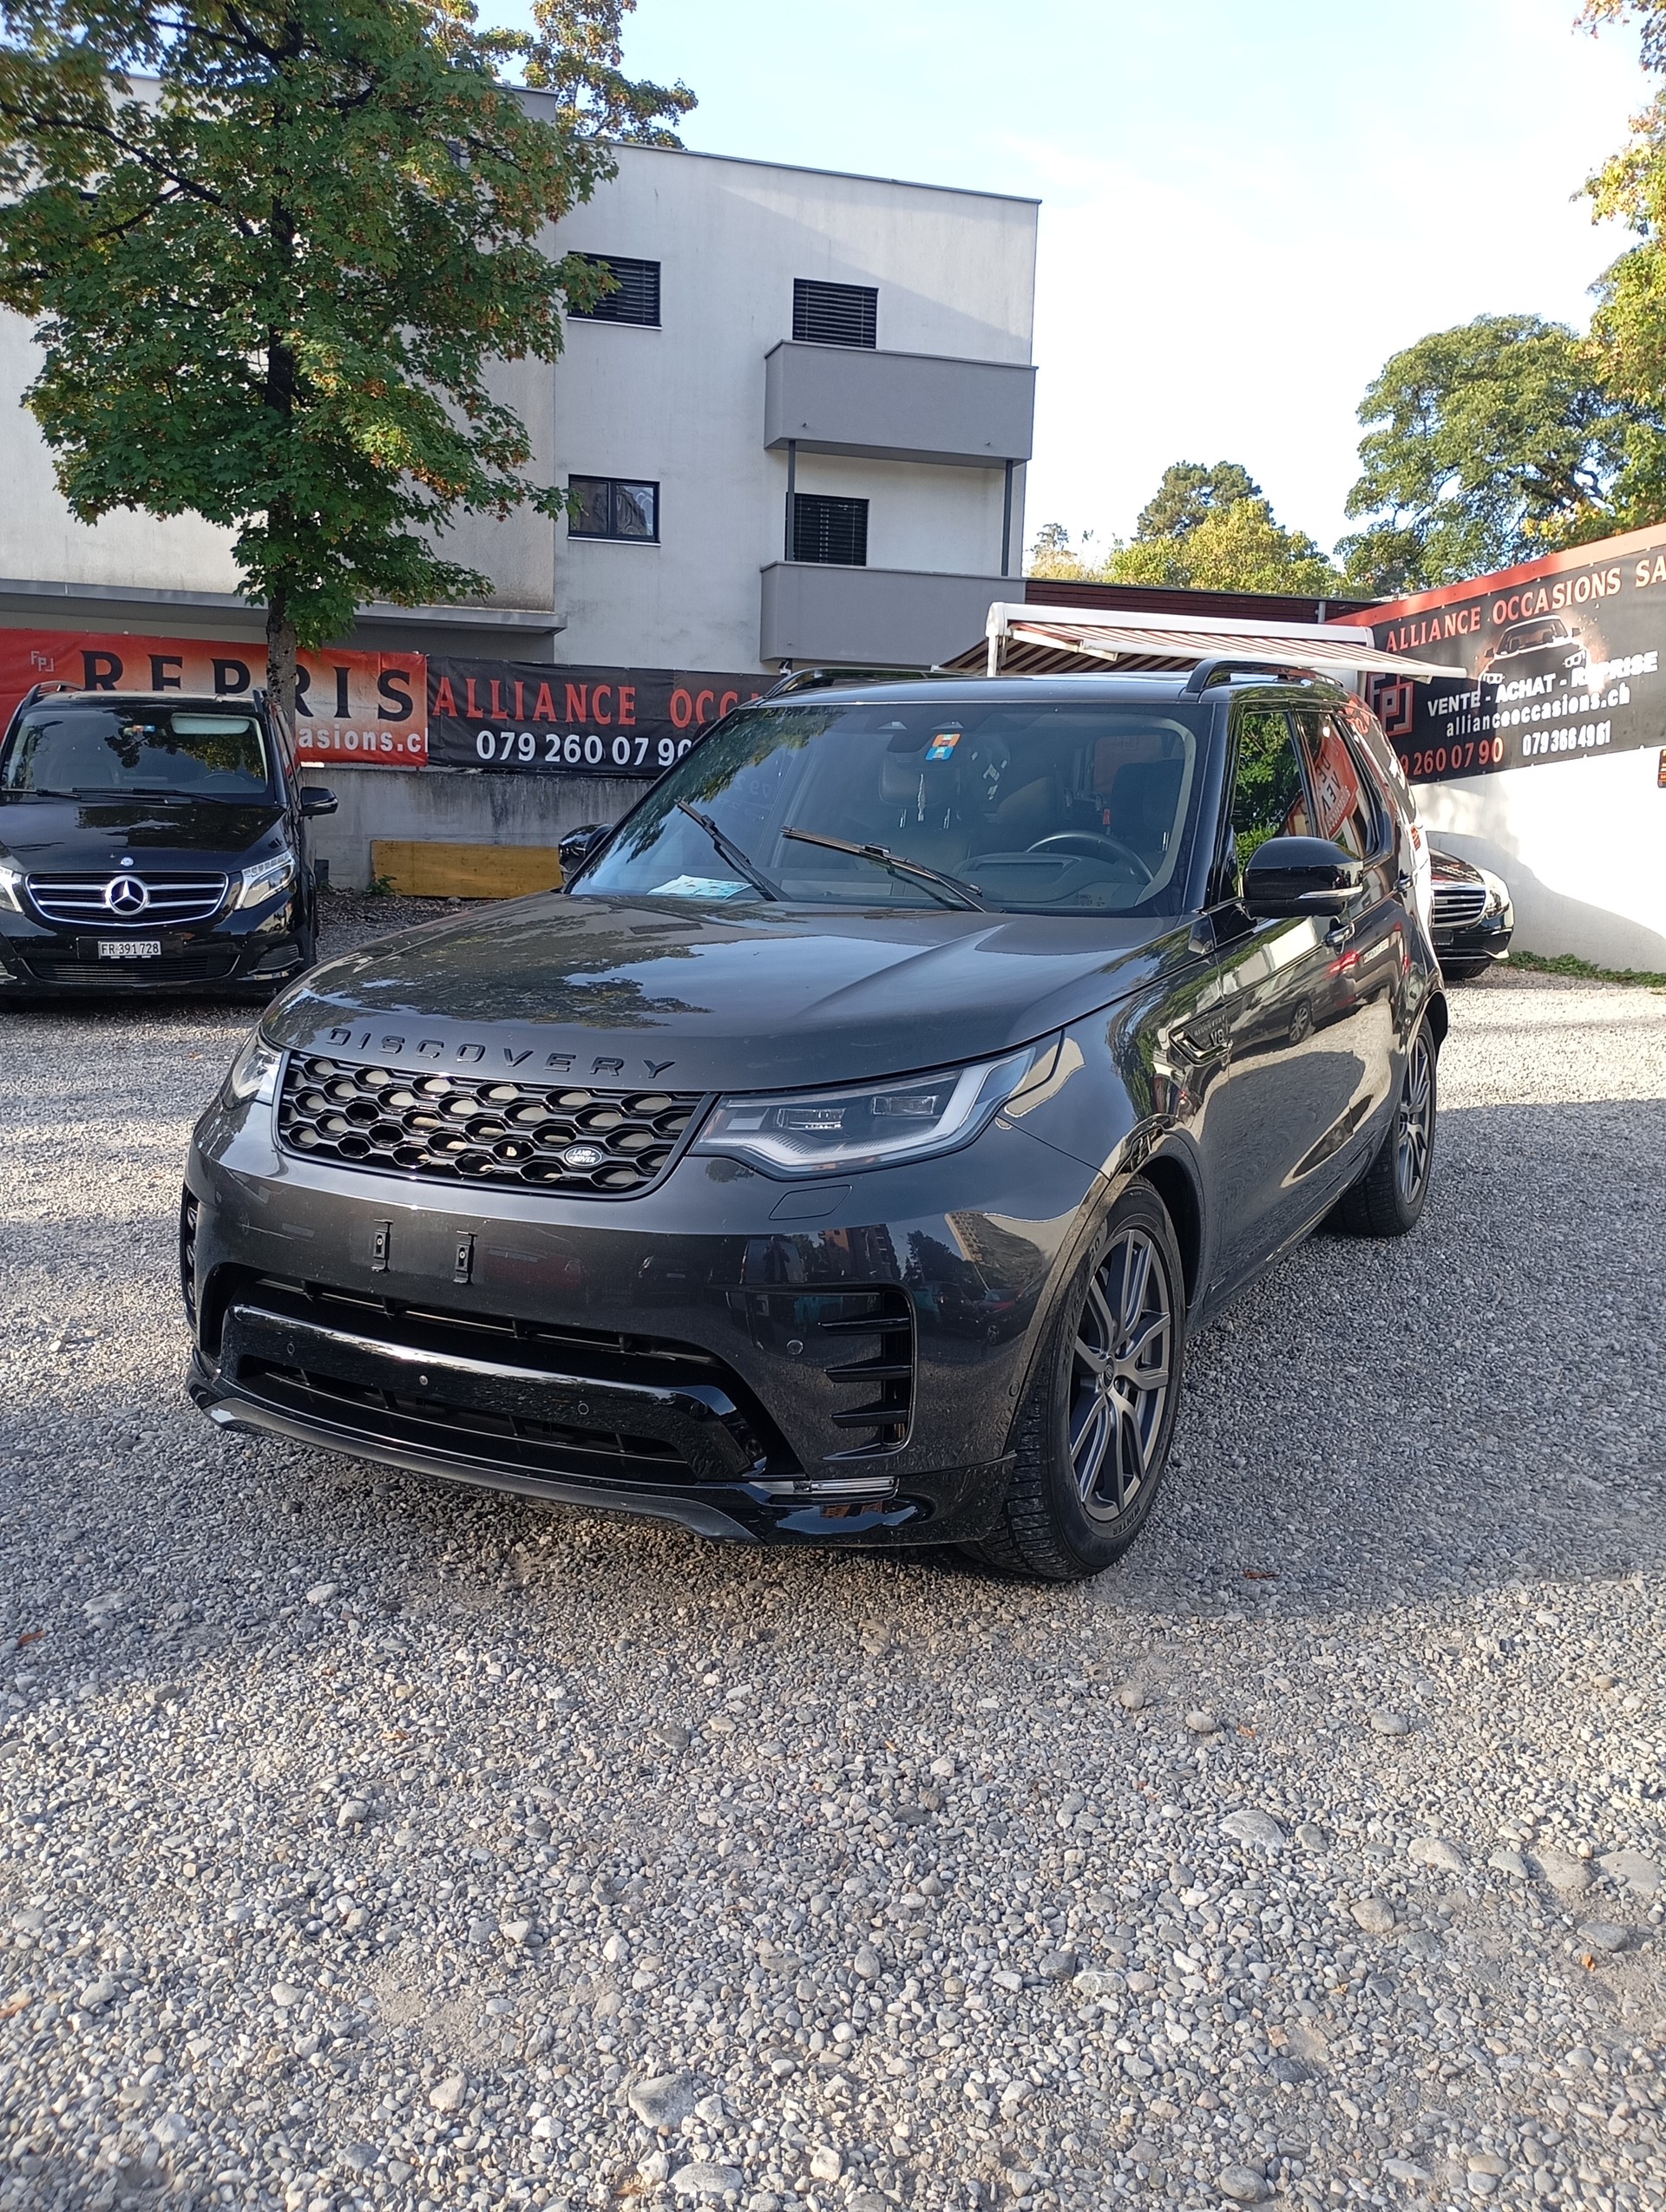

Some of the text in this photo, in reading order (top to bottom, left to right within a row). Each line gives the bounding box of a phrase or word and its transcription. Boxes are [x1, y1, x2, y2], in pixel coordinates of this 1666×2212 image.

[1386, 554, 1666, 651] ALLIANCE OCCASIONS SA
[432, 677, 759, 729] ALLIANCE OCC
[1427, 690, 1481, 717] VENTE
[1494, 673, 1556, 704] ACHAT
[1446, 682, 1631, 737] allianceoccasions.ch
[298, 723, 429, 753] asions.c
[476, 730, 536, 762] 079
[544, 734, 604, 764] 260
[612, 736, 650, 766] 07
[1413, 747, 1446, 776] 260
[1451, 742, 1475, 769] 07
[1478, 736, 1505, 765] 90
[102, 942, 115, 954] FR
[327, 1027, 676, 1079] DISCOVERY
